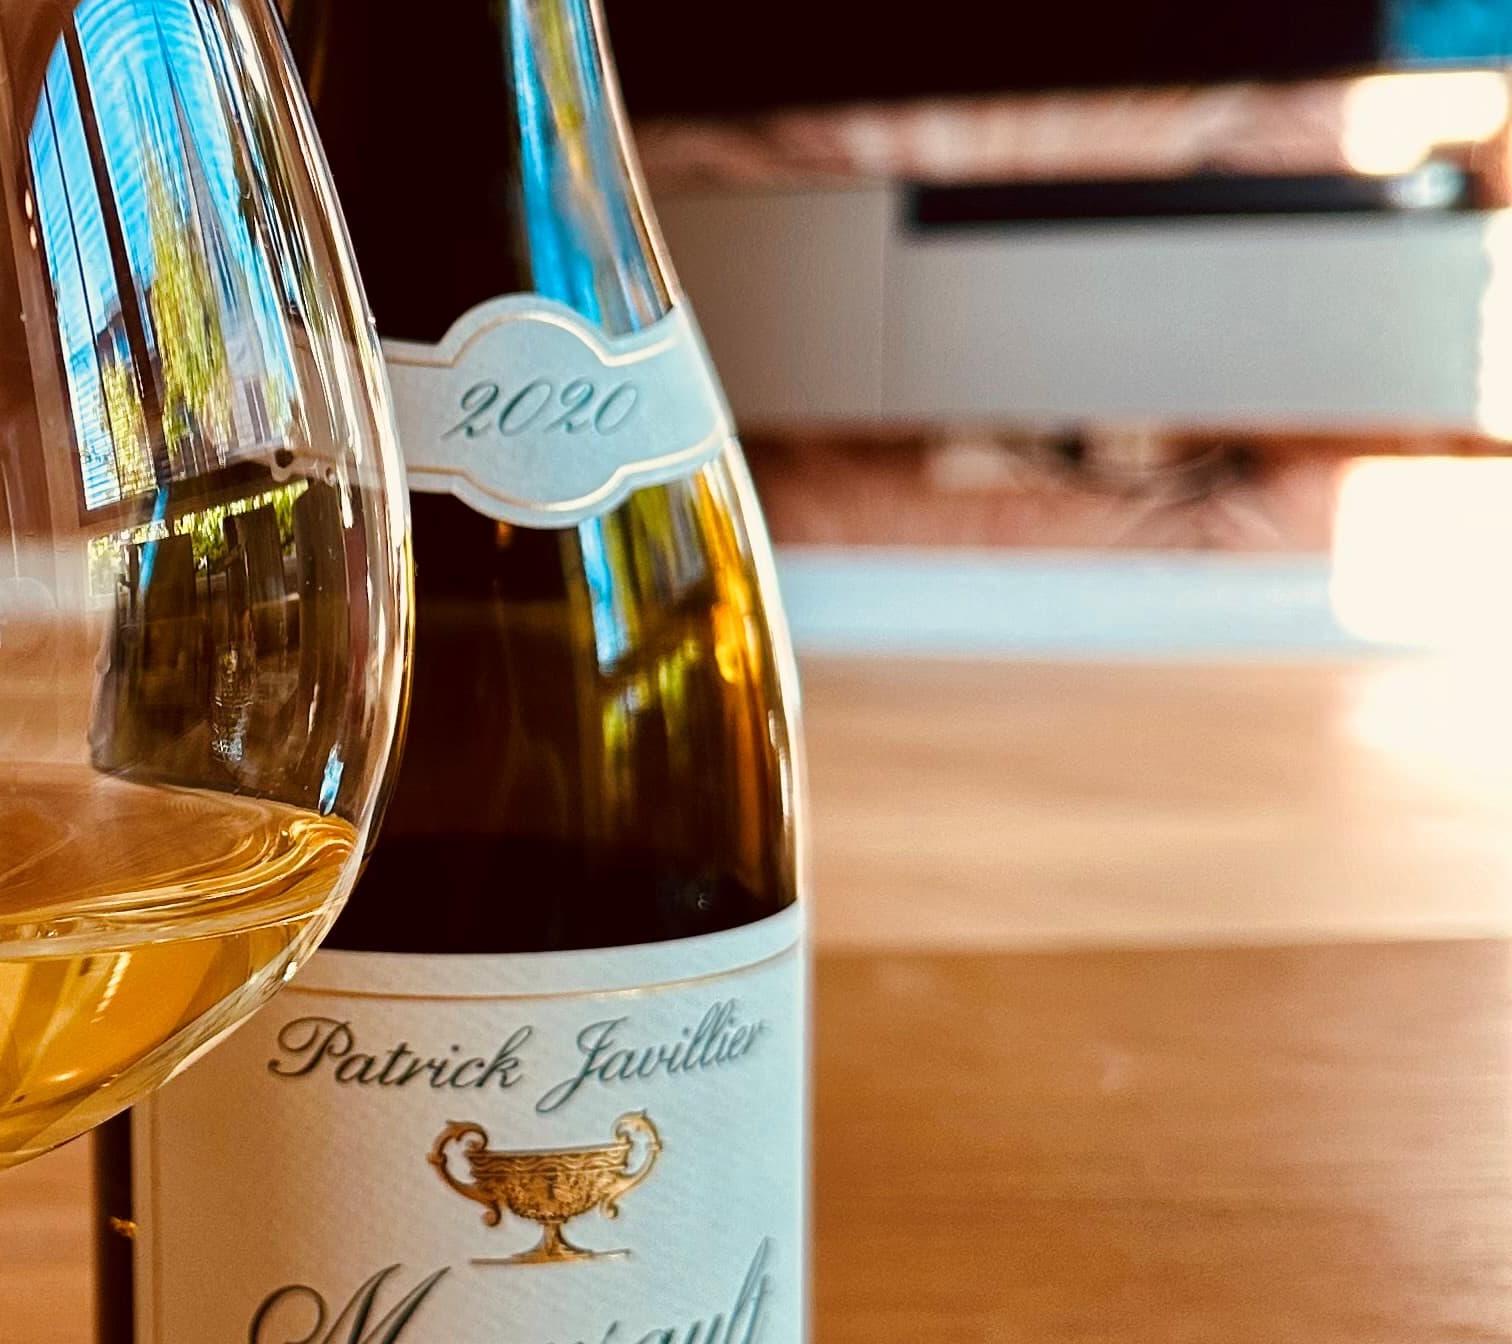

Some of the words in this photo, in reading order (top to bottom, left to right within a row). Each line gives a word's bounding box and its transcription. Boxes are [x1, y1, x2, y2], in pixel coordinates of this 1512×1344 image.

[442, 375, 639, 441] 2020
[266, 1015, 532, 1090] Patrick
[534, 997, 768, 1113] Javillier
